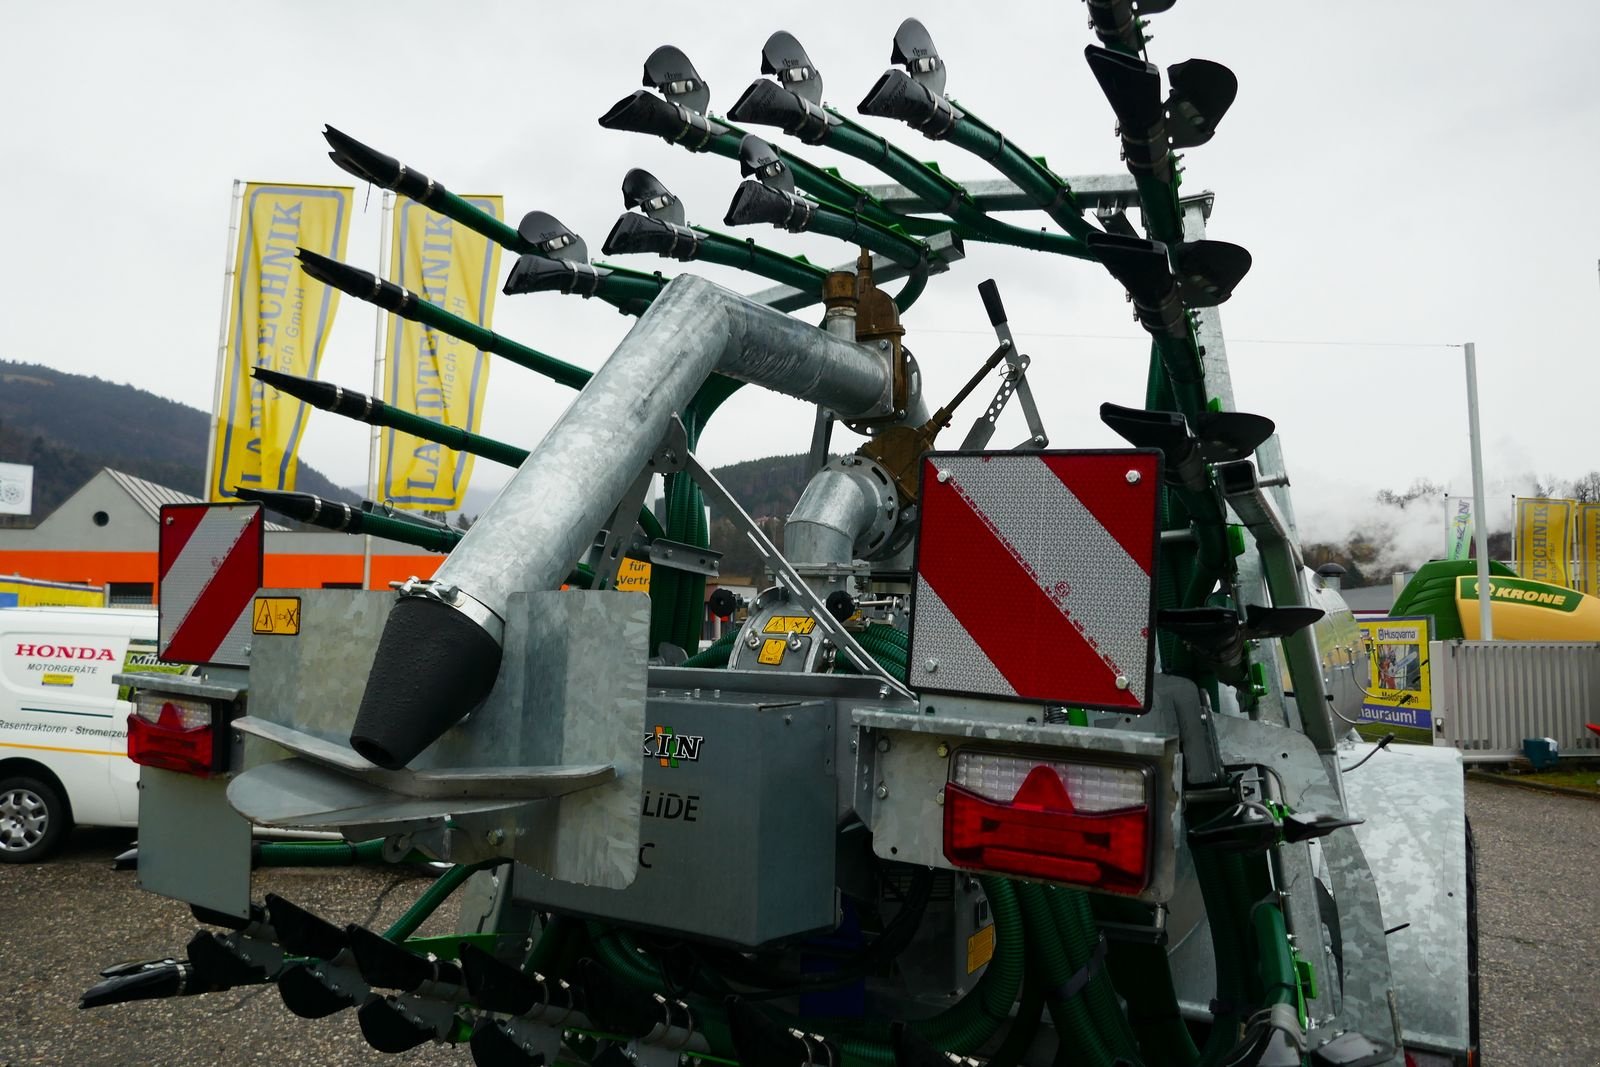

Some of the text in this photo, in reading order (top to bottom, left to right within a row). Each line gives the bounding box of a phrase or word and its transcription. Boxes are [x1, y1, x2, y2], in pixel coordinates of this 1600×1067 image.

[286, 287, 305, 338] GmbH
[629, 560, 647, 571] für
[1496, 587, 1567, 606] KRONE
[1384, 629, 1416, 640] Husqvarna
[15, 643, 116, 662] HONDA
[27, 663, 99, 674] MOTORGERÄTE
[0, 719, 67, 734] Rasentraktoren
